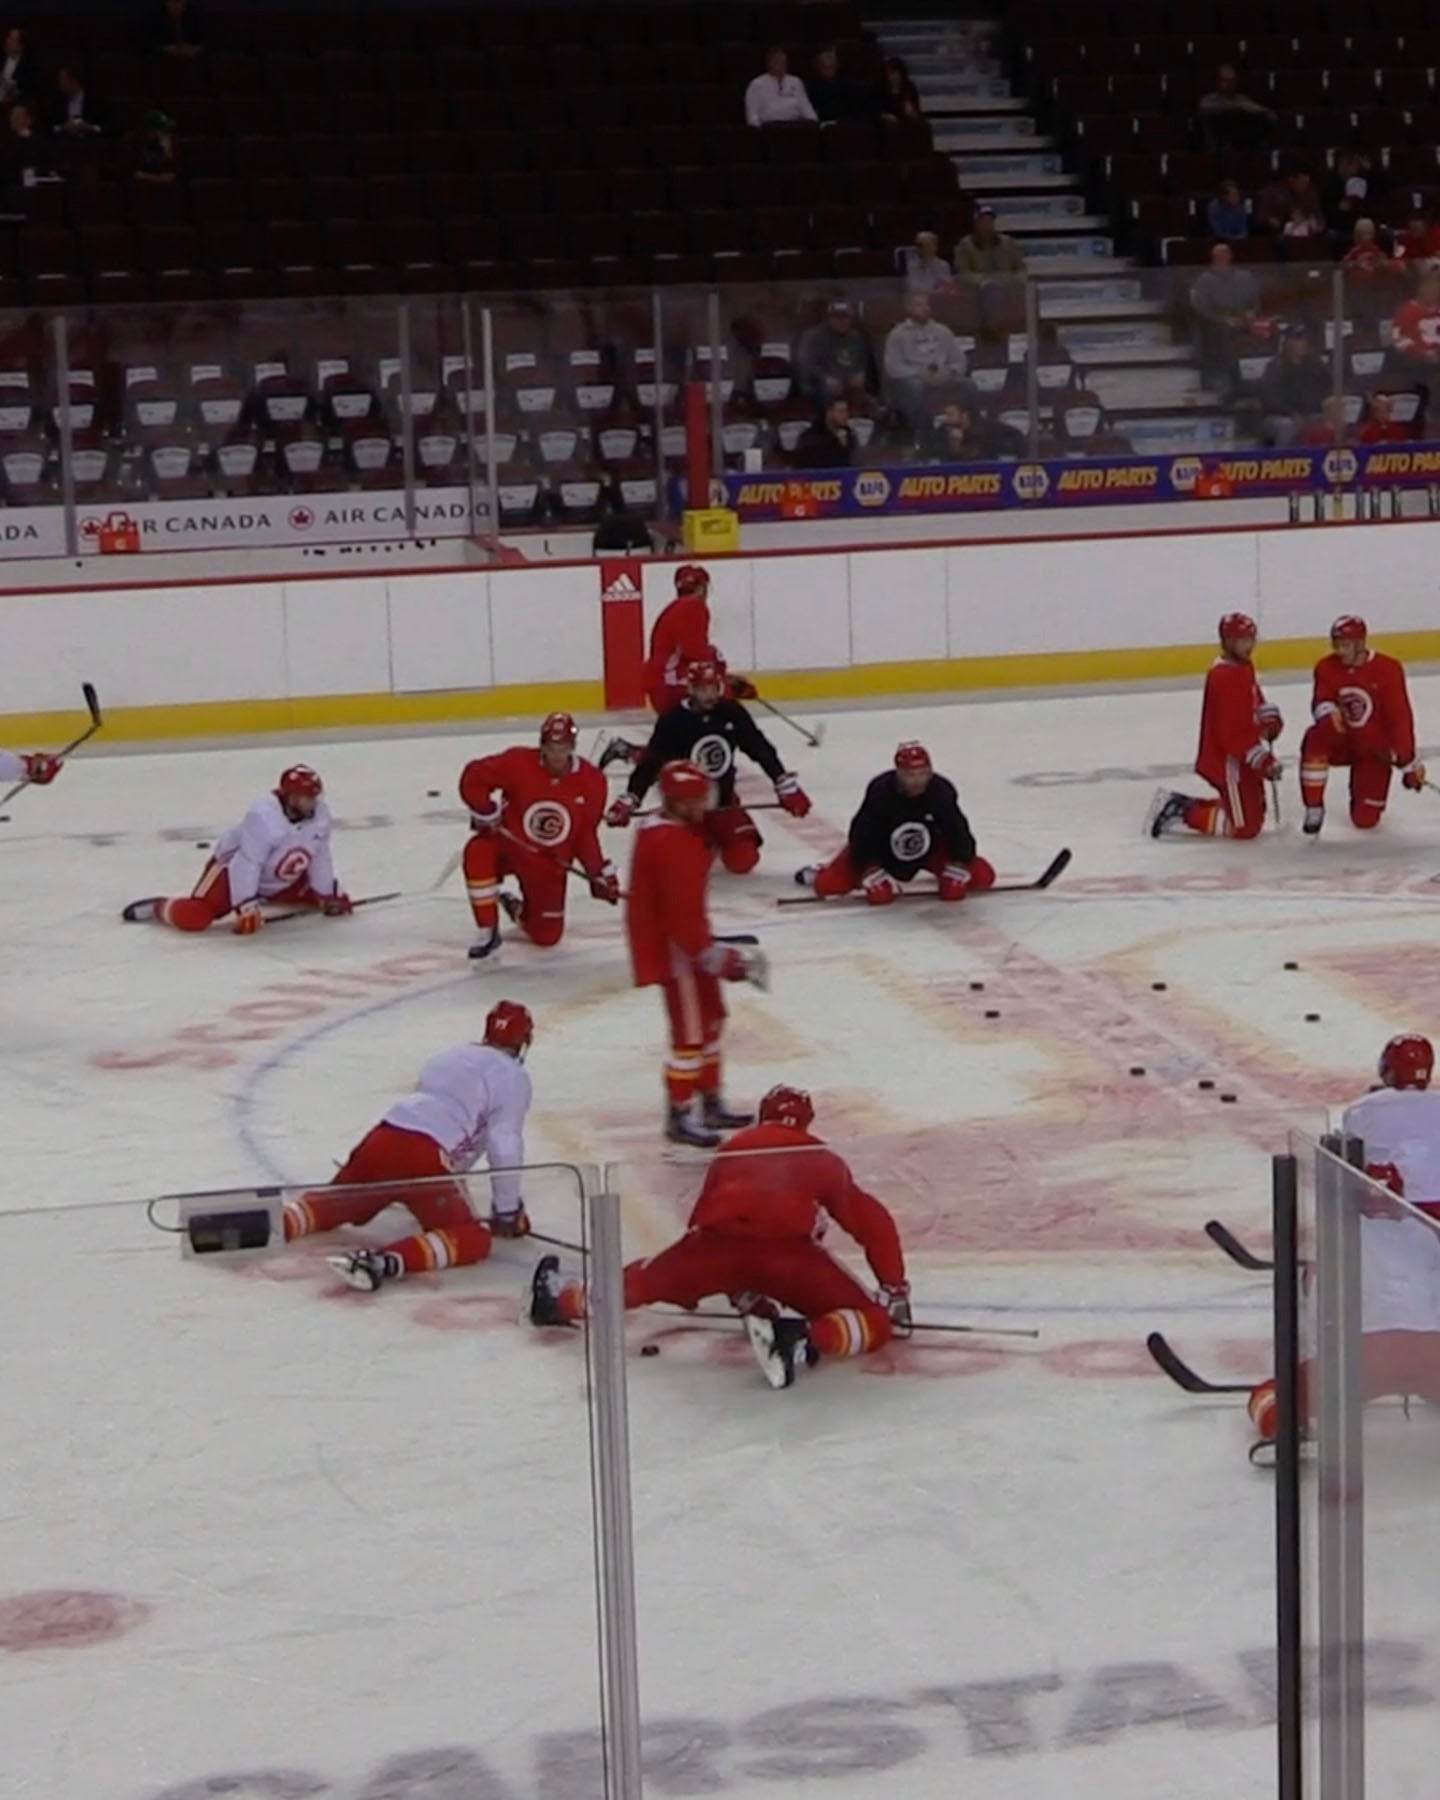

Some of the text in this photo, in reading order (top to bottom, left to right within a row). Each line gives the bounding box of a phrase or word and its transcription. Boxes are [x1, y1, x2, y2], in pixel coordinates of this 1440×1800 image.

[1260, 458, 1313, 479] PARTS
[1366, 452, 1411, 474] AUTO
[898, 473, 1002, 498] AUTO PARTS
[1057, 467, 1159, 491] AUTO PARTS
[165, 513, 272, 533] CANADA
[324, 508, 366, 525] AIR
